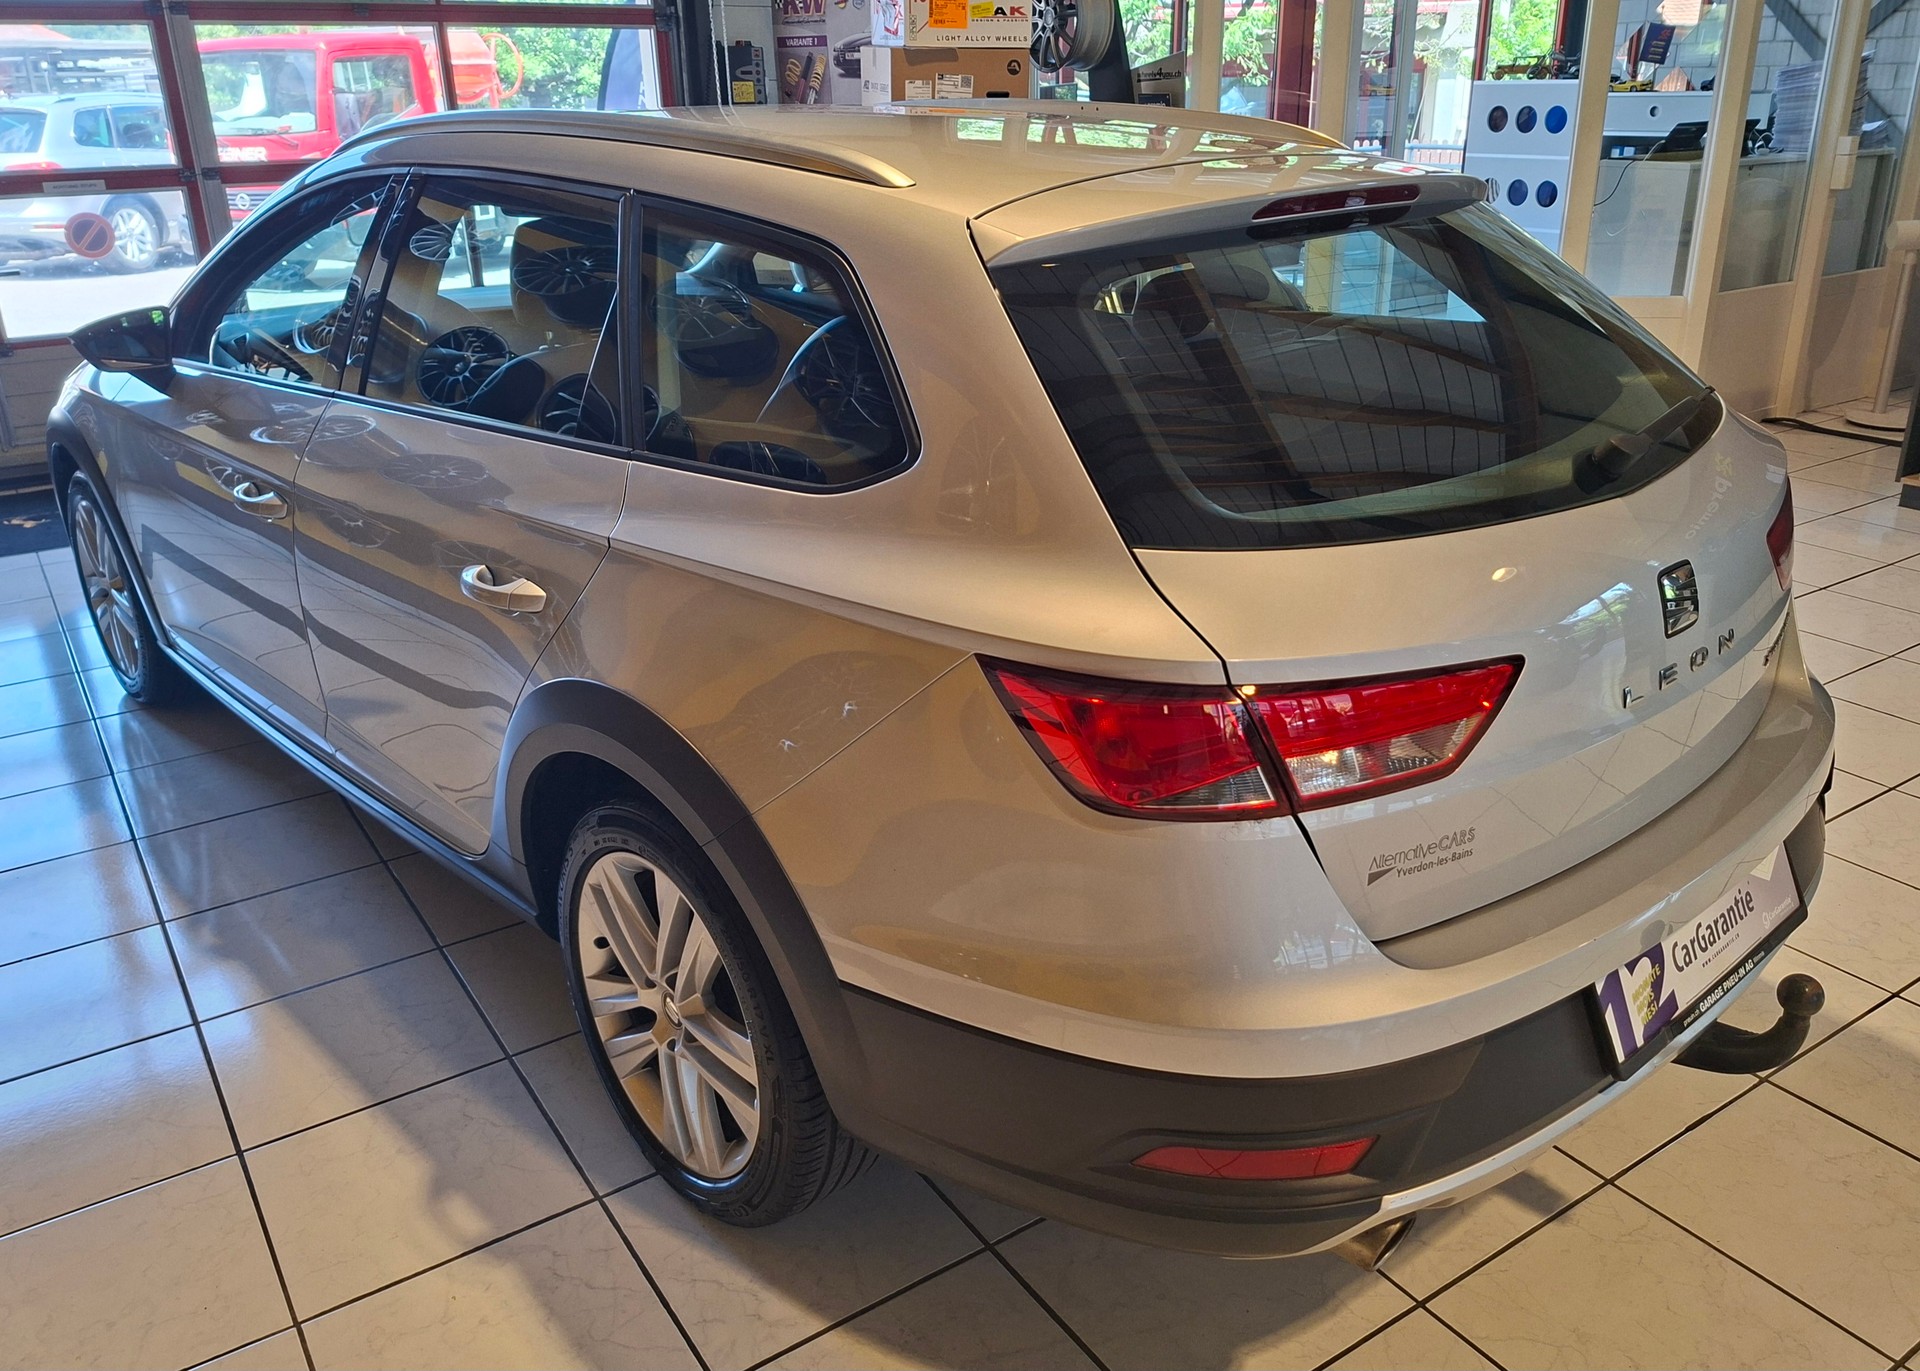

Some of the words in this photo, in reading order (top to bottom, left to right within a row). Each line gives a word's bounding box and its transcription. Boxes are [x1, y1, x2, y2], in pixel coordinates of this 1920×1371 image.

[785, 38, 813, 46] VARIANTE
[1622, 627, 1735, 709] LEON
[1396, 847, 1474, 878] Yverdon-les-Bains
[1671, 887, 1755, 974] CarGarantie
[1599, 941, 1679, 1057] 12
[1631, 962, 1662, 1005] MONATE
[1699, 985, 1724, 1012] GARAGE
[1722, 964, 1746, 992] PNEU-IN
[1744, 958, 1754, 974] AG
[1640, 1000, 1658, 1025] MESI
